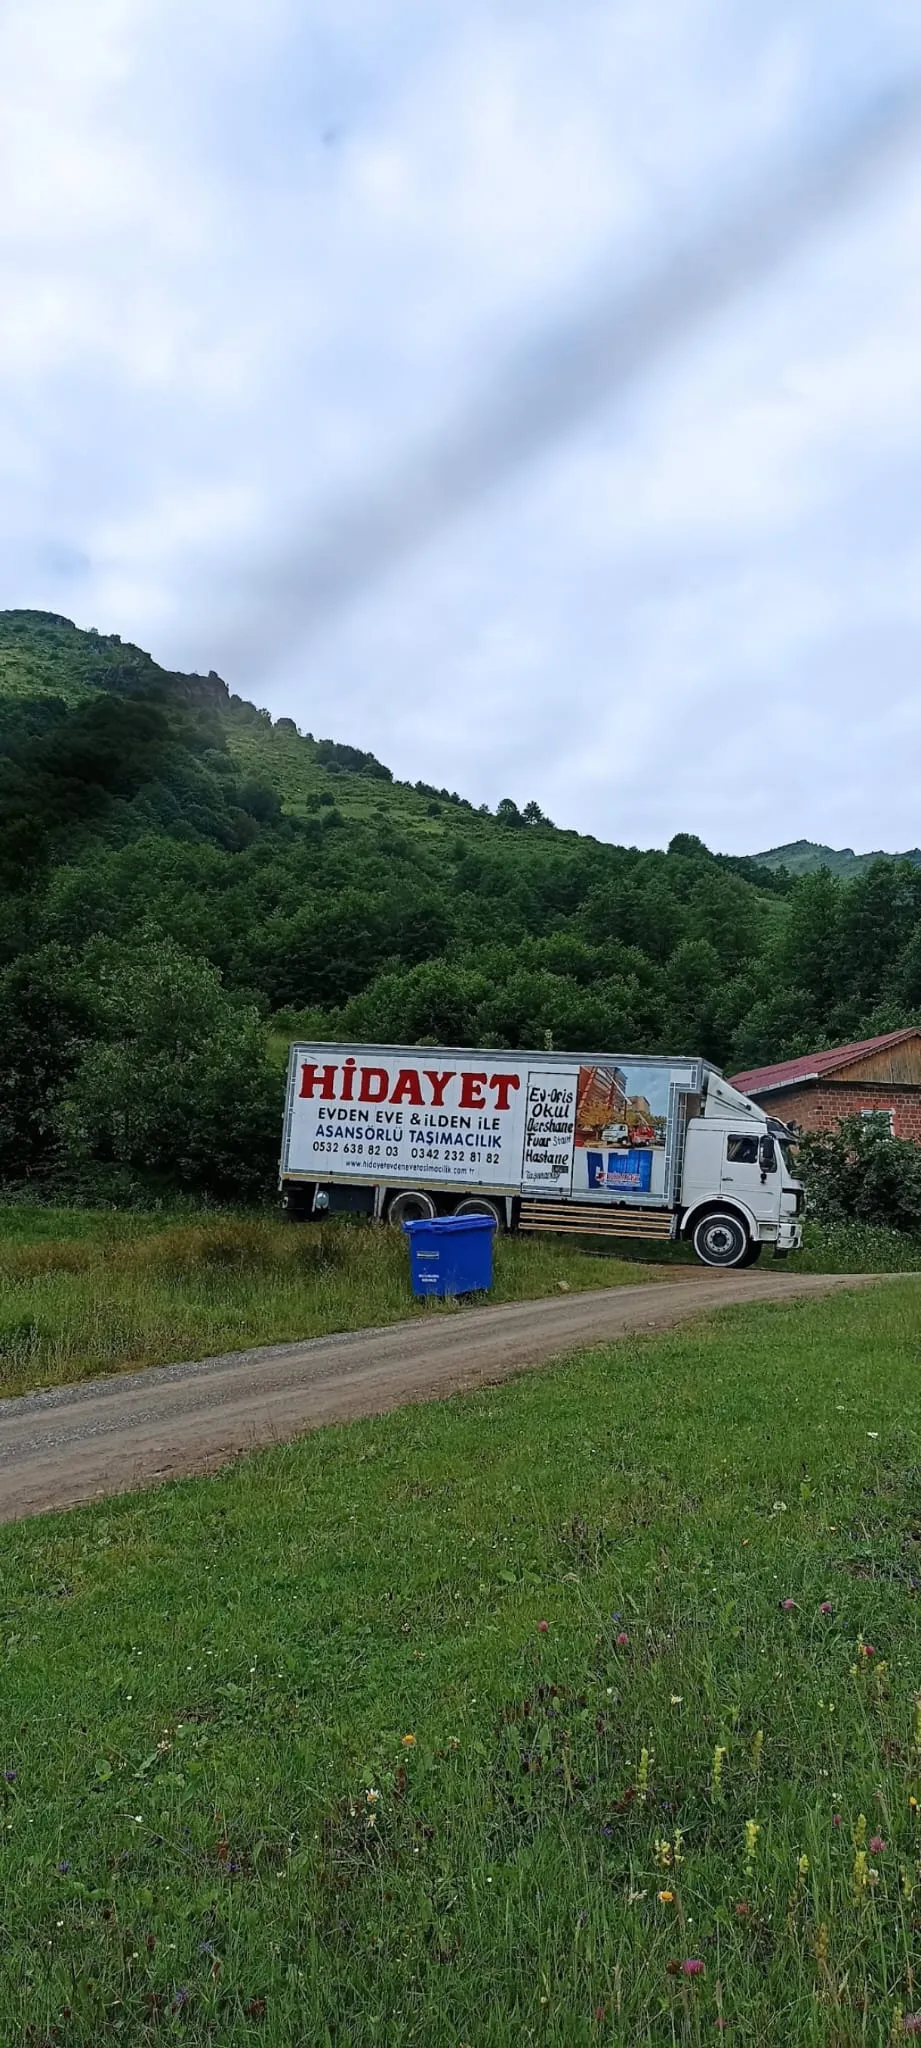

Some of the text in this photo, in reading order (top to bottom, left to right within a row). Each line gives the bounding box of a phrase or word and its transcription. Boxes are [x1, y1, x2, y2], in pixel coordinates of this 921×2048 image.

[299, 1057, 520, 1110] HİDAYET
[318, 1107, 369, 1122] EVDEN
[376, 1110, 403, 1124] EVE
[409, 1112, 421, 1125] &
[532, 1103, 569, 1118] Okul
[526, 1117, 574, 1133] Dershane
[315, 1124, 502, 1148] ASANSÖRLÜ TAŞIMACILIK
[526, 1133, 551, 1147] Fuar
[312, 1141, 500, 1164] 0532 638 82 03 0342 232 81 82
[525, 1149, 569, 1165] Hastane
